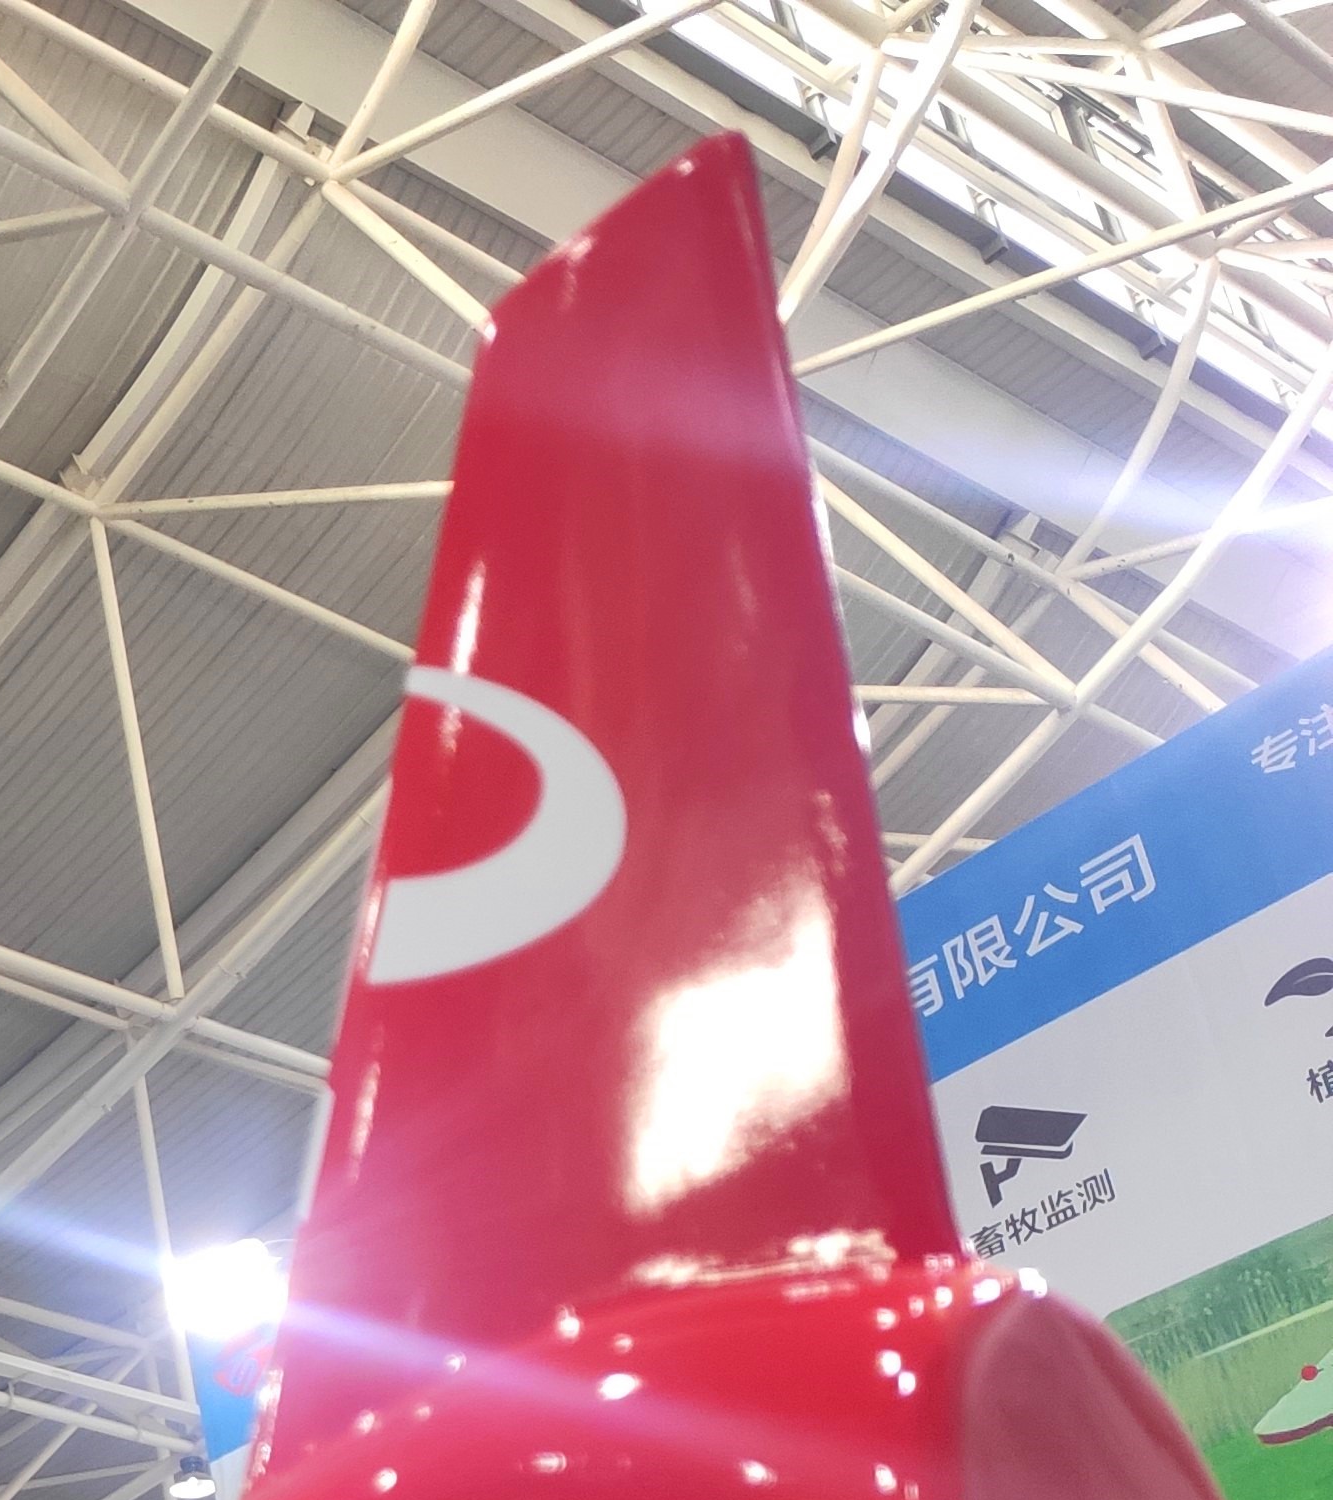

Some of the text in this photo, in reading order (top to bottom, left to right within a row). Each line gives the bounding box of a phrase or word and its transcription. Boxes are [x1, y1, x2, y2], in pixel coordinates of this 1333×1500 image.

[908, 834, 1157, 1018] 有限公司
[971, 1168, 1116, 1260] 畜牧监测
